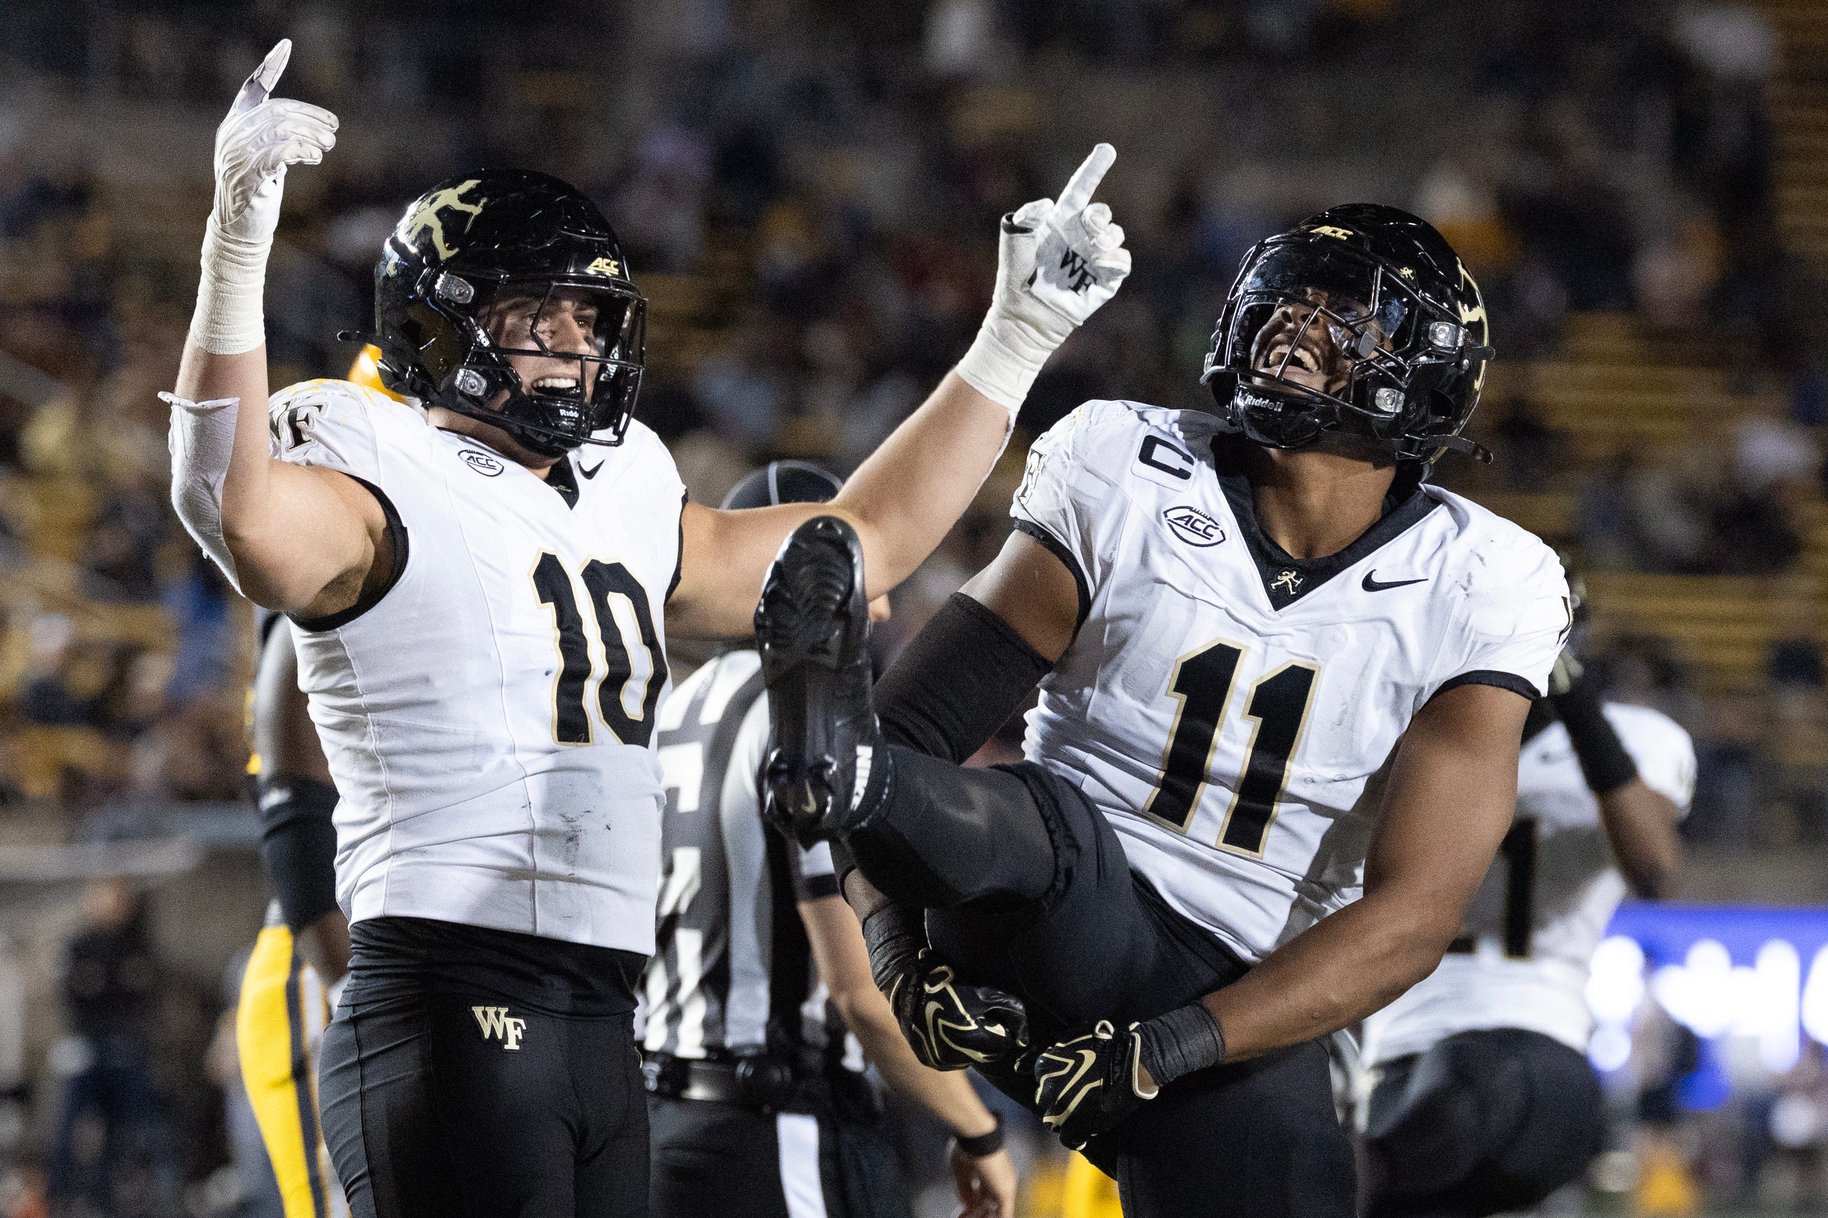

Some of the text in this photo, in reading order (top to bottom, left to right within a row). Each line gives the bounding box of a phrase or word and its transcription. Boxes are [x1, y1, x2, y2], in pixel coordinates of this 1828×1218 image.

[1310, 225, 1353, 240] ACC
[587, 257, 619, 274] ACC
[1060, 246, 1097, 296] WF
[559, 408, 579, 418] Ridd
[1245, 394, 1284, 412] Riddell
[466, 455, 497, 468] ACC
[1138, 435, 1194, 480] C
[1172, 514, 1220, 538] ACC
[528, 547, 669, 749] 10
[1141, 637, 1321, 860] 11
[472, 1006, 527, 1050] WF
